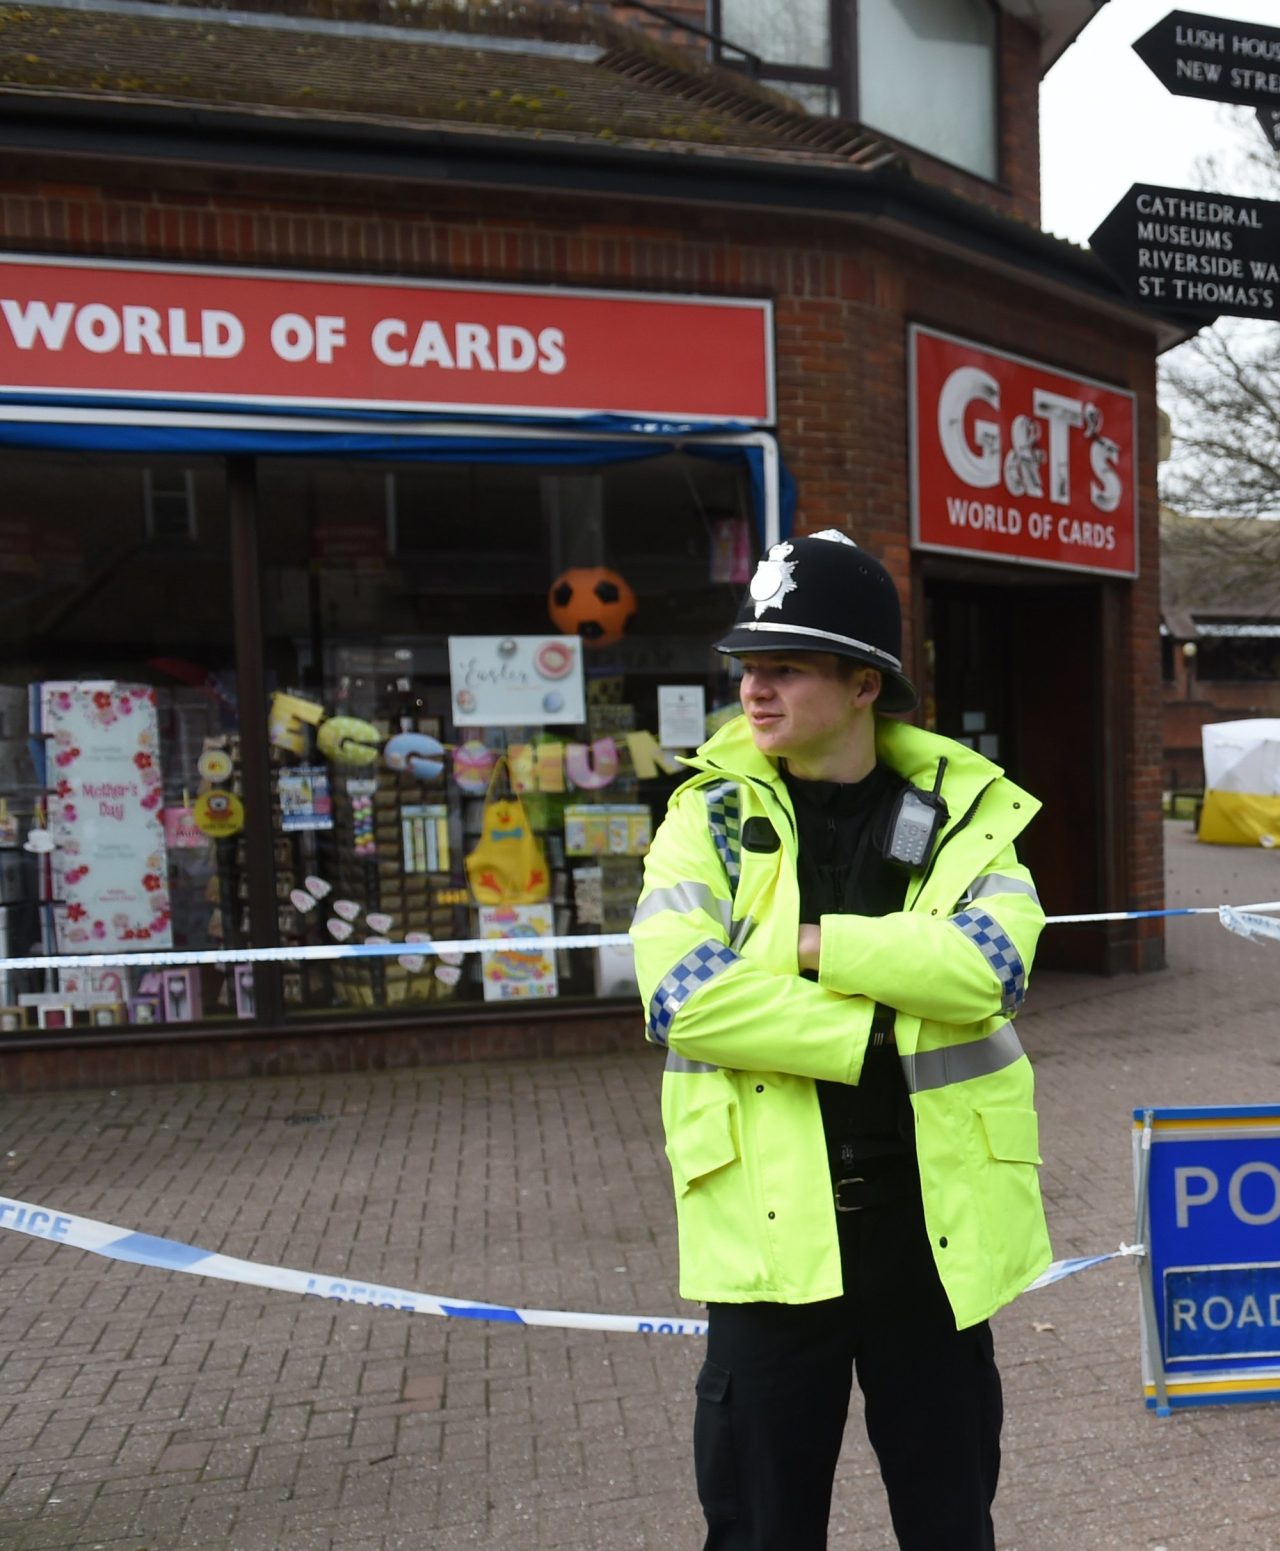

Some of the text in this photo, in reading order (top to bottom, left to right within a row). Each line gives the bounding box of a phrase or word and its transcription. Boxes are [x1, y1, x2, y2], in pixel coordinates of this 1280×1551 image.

[1175, 25, 1225, 53] LUSH
[1176, 58, 1222, 83] NEW
[1136, 193, 1263, 229] CATHEDRAL
[1137, 220, 1233, 251] MUSEUMS
[1138, 248, 1244, 279] RIVERSIDE
[1138, 275, 1166, 297] ST.
[1172, 278, 1274, 309] THOMAS'S
[0, 299, 567, 376] WORLD OF CARDS
[946, 496, 1116, 550] WORLD OF CARDS
[81, 780, 138, 800] Mother's
[99, 799, 125, 821] Day
